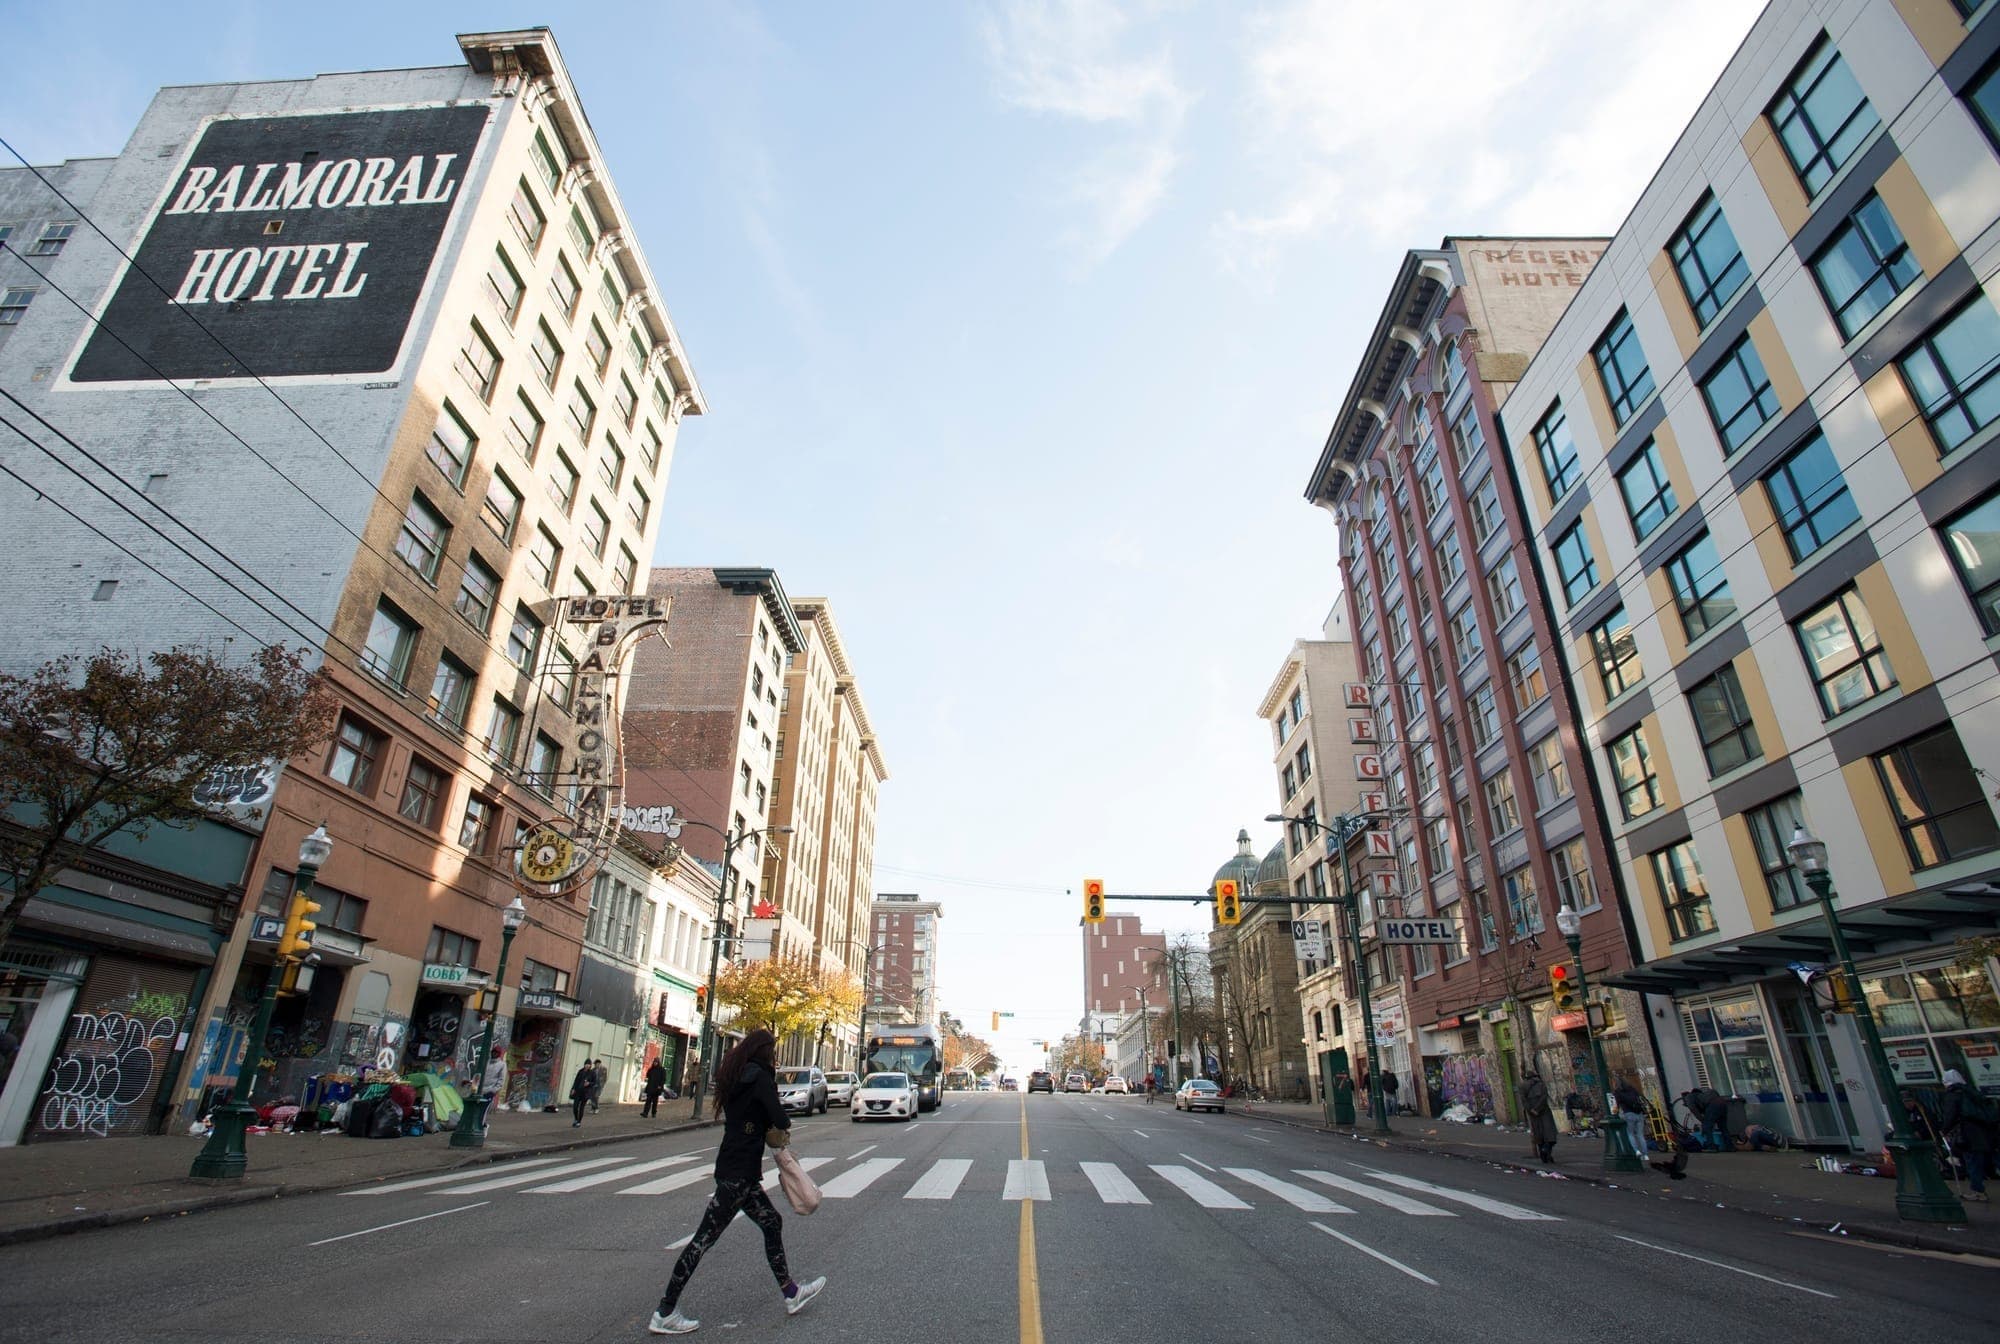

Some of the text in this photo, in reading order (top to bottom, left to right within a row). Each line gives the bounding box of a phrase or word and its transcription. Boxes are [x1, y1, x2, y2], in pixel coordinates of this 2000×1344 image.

[165, 153, 458, 215] BALMORAL
[1484, 249, 1604, 264] REGENT
[168, 242, 369, 304] HOTEL
[1501, 272, 1590, 286] HOTE
[570, 599, 663, 617] HOTEL
[574, 621, 617, 839] BALMORAL
[1349, 686, 1396, 895] REGENT
[1387, 923, 1452, 940] HOTEL
[425, 967, 464, 981] LOBBY
[523, 994, 551, 1006] PUB
